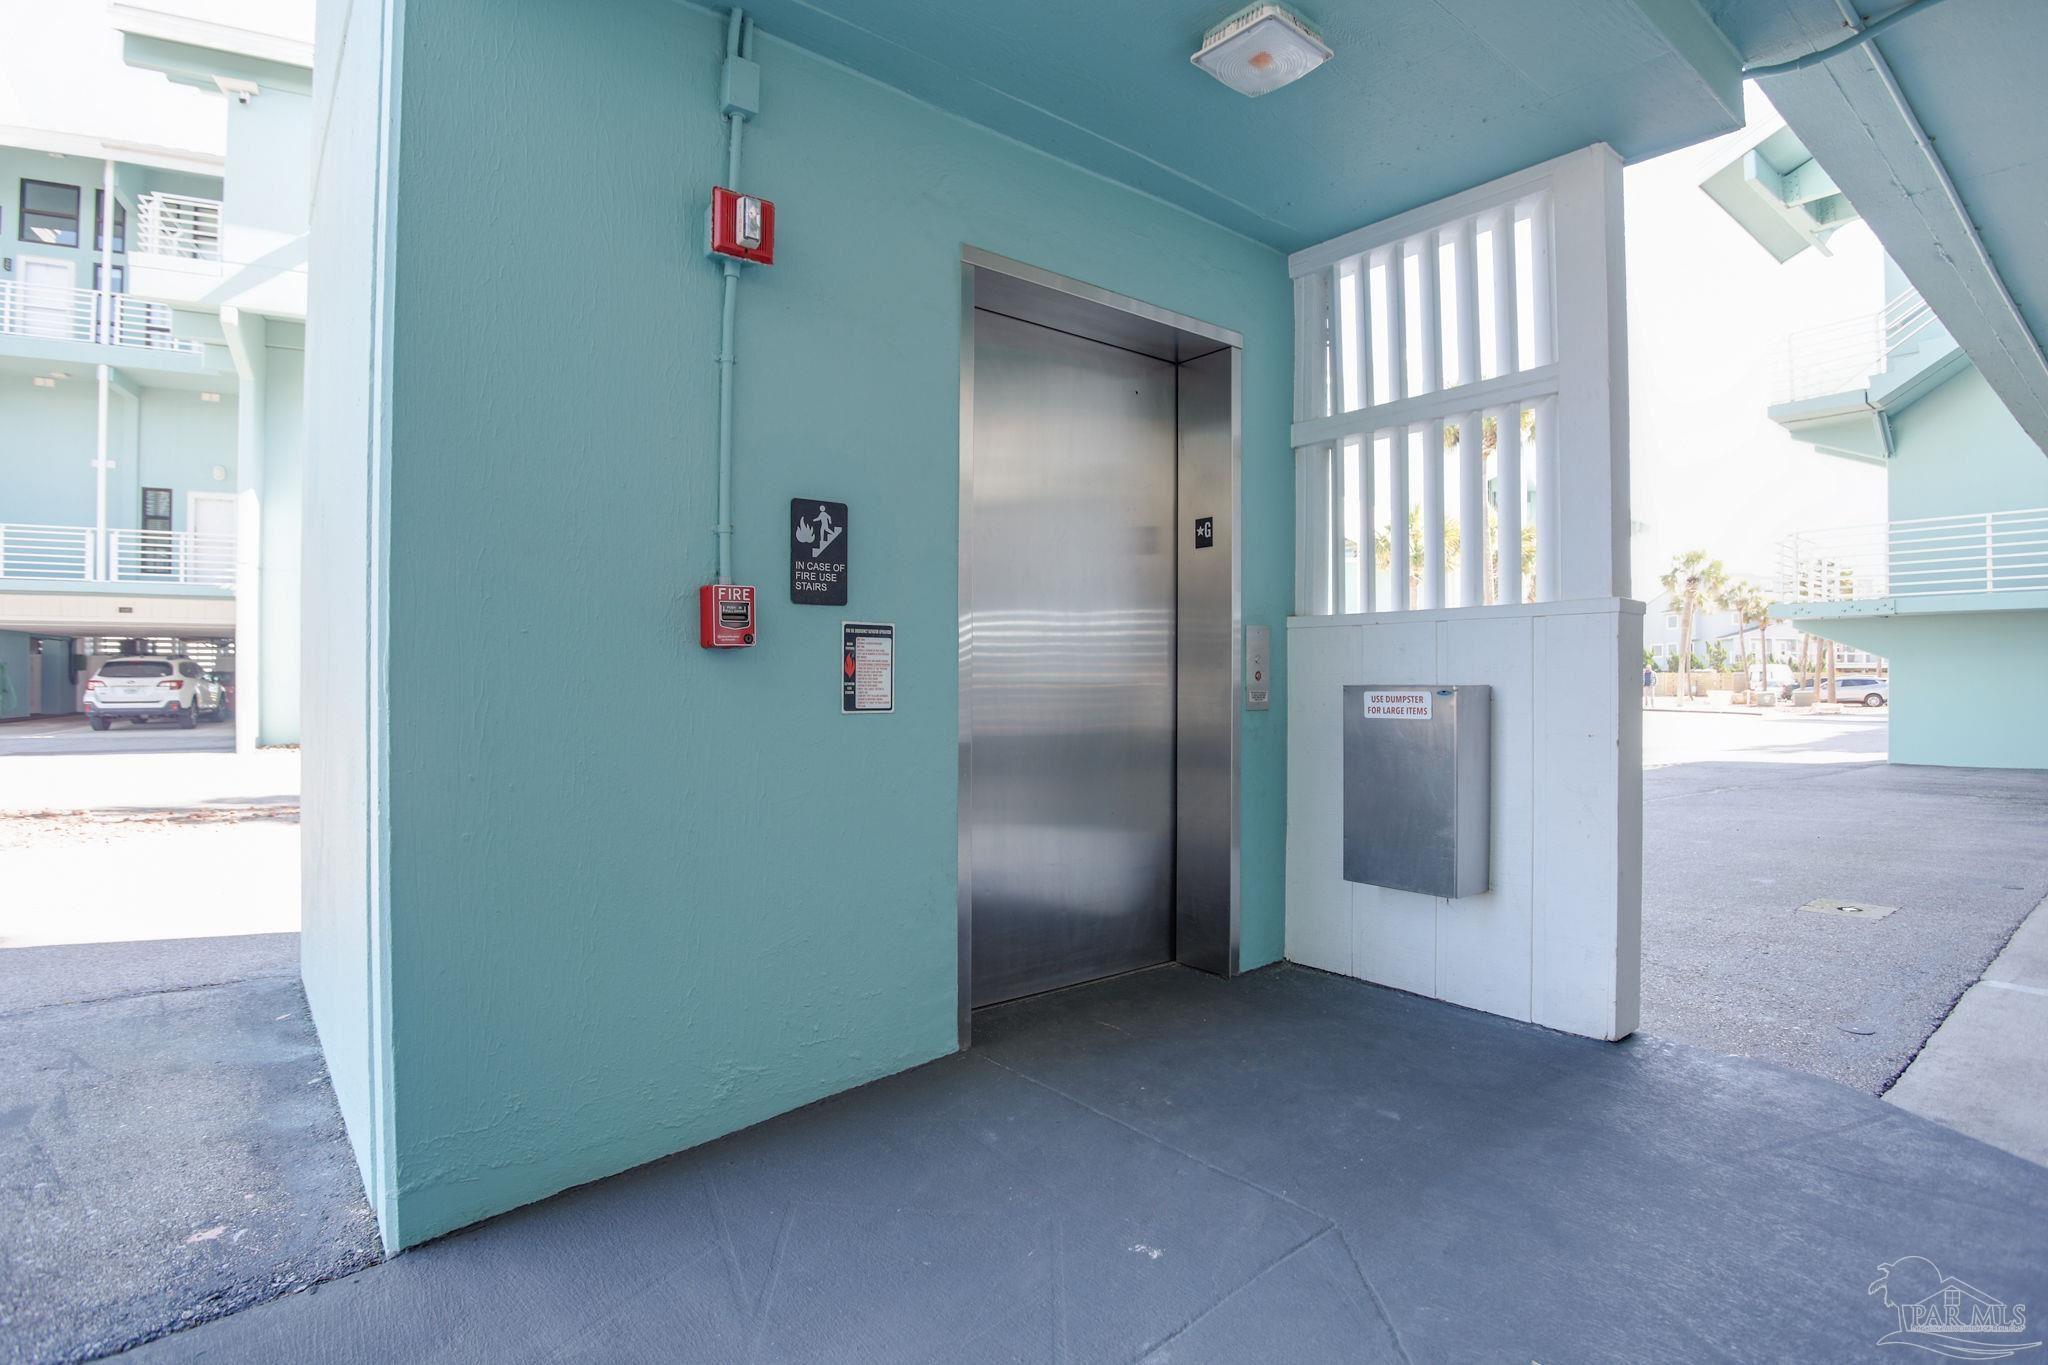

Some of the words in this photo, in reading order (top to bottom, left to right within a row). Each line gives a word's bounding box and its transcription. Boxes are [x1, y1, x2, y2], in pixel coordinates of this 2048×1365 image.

[1204, 522, 1211, 538] G
[795, 561, 804, 570] IN
[806, 562, 830, 571] CASE
[832, 564, 845, 572] OF
[795, 572, 816, 580] FIRE
[819, 573, 837, 582] USE
[795, 582, 827, 592] STAIRS
[718, 588, 750, 600] FIRE
[1386, 696, 1424, 704] DUMPSTER
[1382, 706, 1404, 714] LARGE
[1406, 707, 1428, 716] ITEMS
